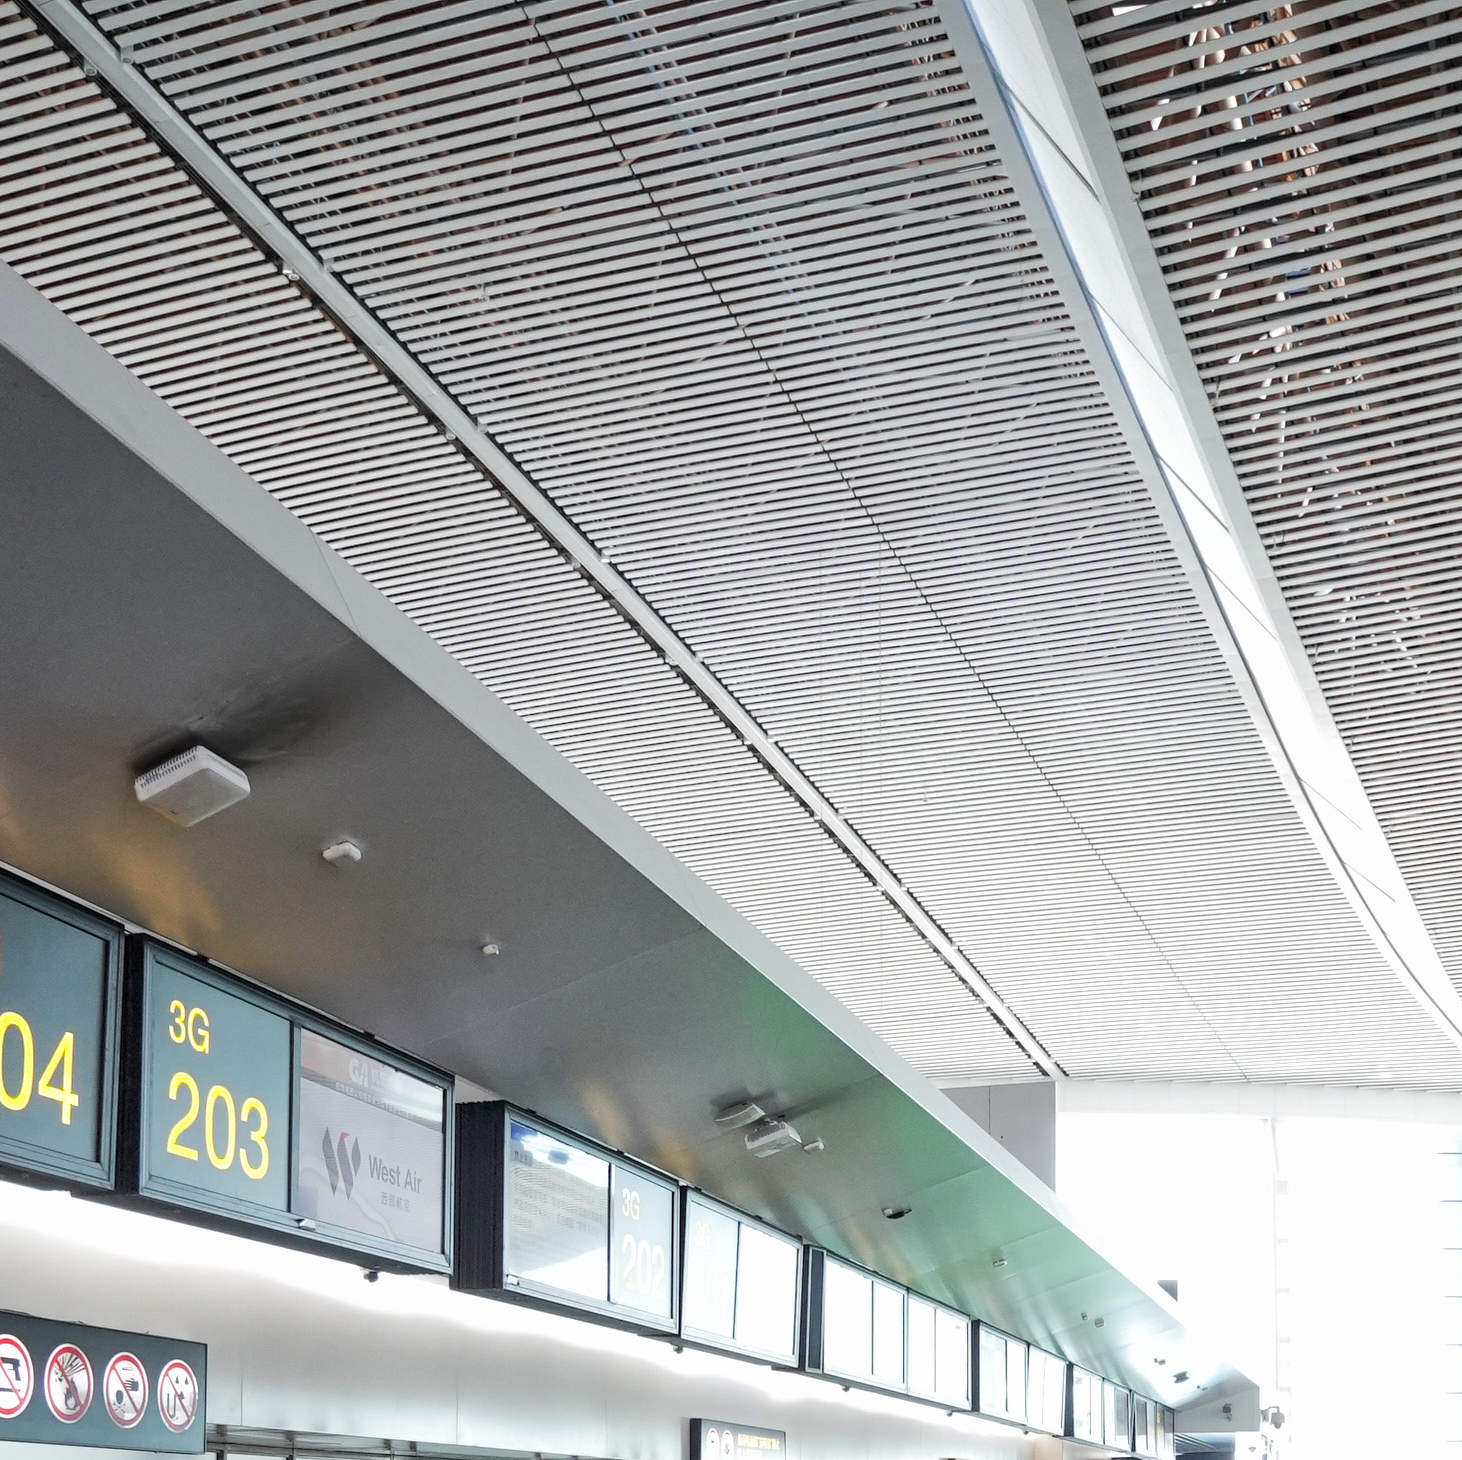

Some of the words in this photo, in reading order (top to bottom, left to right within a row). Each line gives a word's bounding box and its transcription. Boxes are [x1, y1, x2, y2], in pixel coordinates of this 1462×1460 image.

[168, 998, 210, 1055] 3G
[165, 1070, 271, 1180] 203
[368, 1154, 401, 1187] West
[404, 1168, 423, 1194] Air
[622, 1188, 640, 1220] 3G
[622, 1234, 665, 1296] 202
